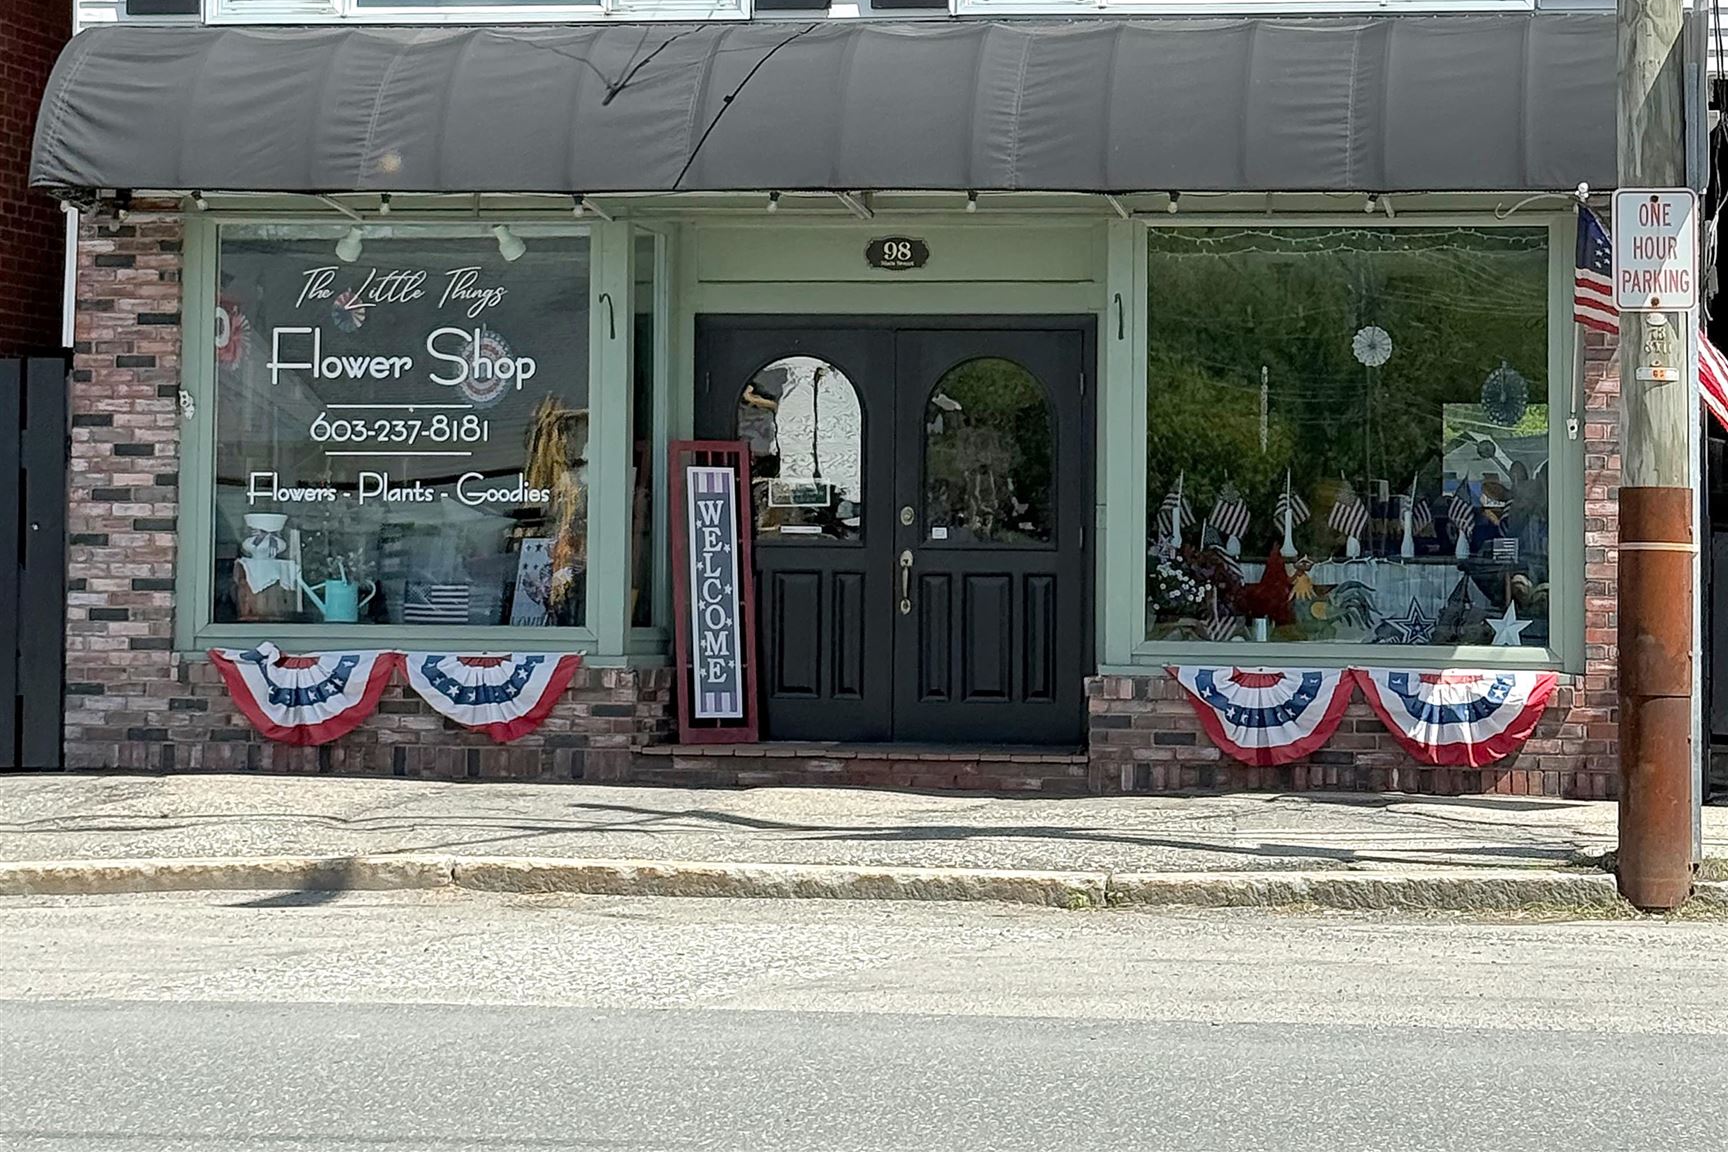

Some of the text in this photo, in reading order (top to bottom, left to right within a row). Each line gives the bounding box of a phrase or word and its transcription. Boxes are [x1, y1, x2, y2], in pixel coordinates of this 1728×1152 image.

[1638, 203, 1672, 227] ONE
[883, 241, 912, 261] 98
[1633, 236, 1677, 260] HOUR
[296, 266, 507, 318] The Little Things
[1622, 269, 1690, 294] PARKING
[267, 327, 536, 390] Flower Shop
[309, 411, 490, 444] 603-237-8181
[246, 472, 337, 505] Flowers
[358, 472, 433, 505] Plants
[456, 472, 551, 505] Goodies
[697, 500, 730, 684] WELCOME
